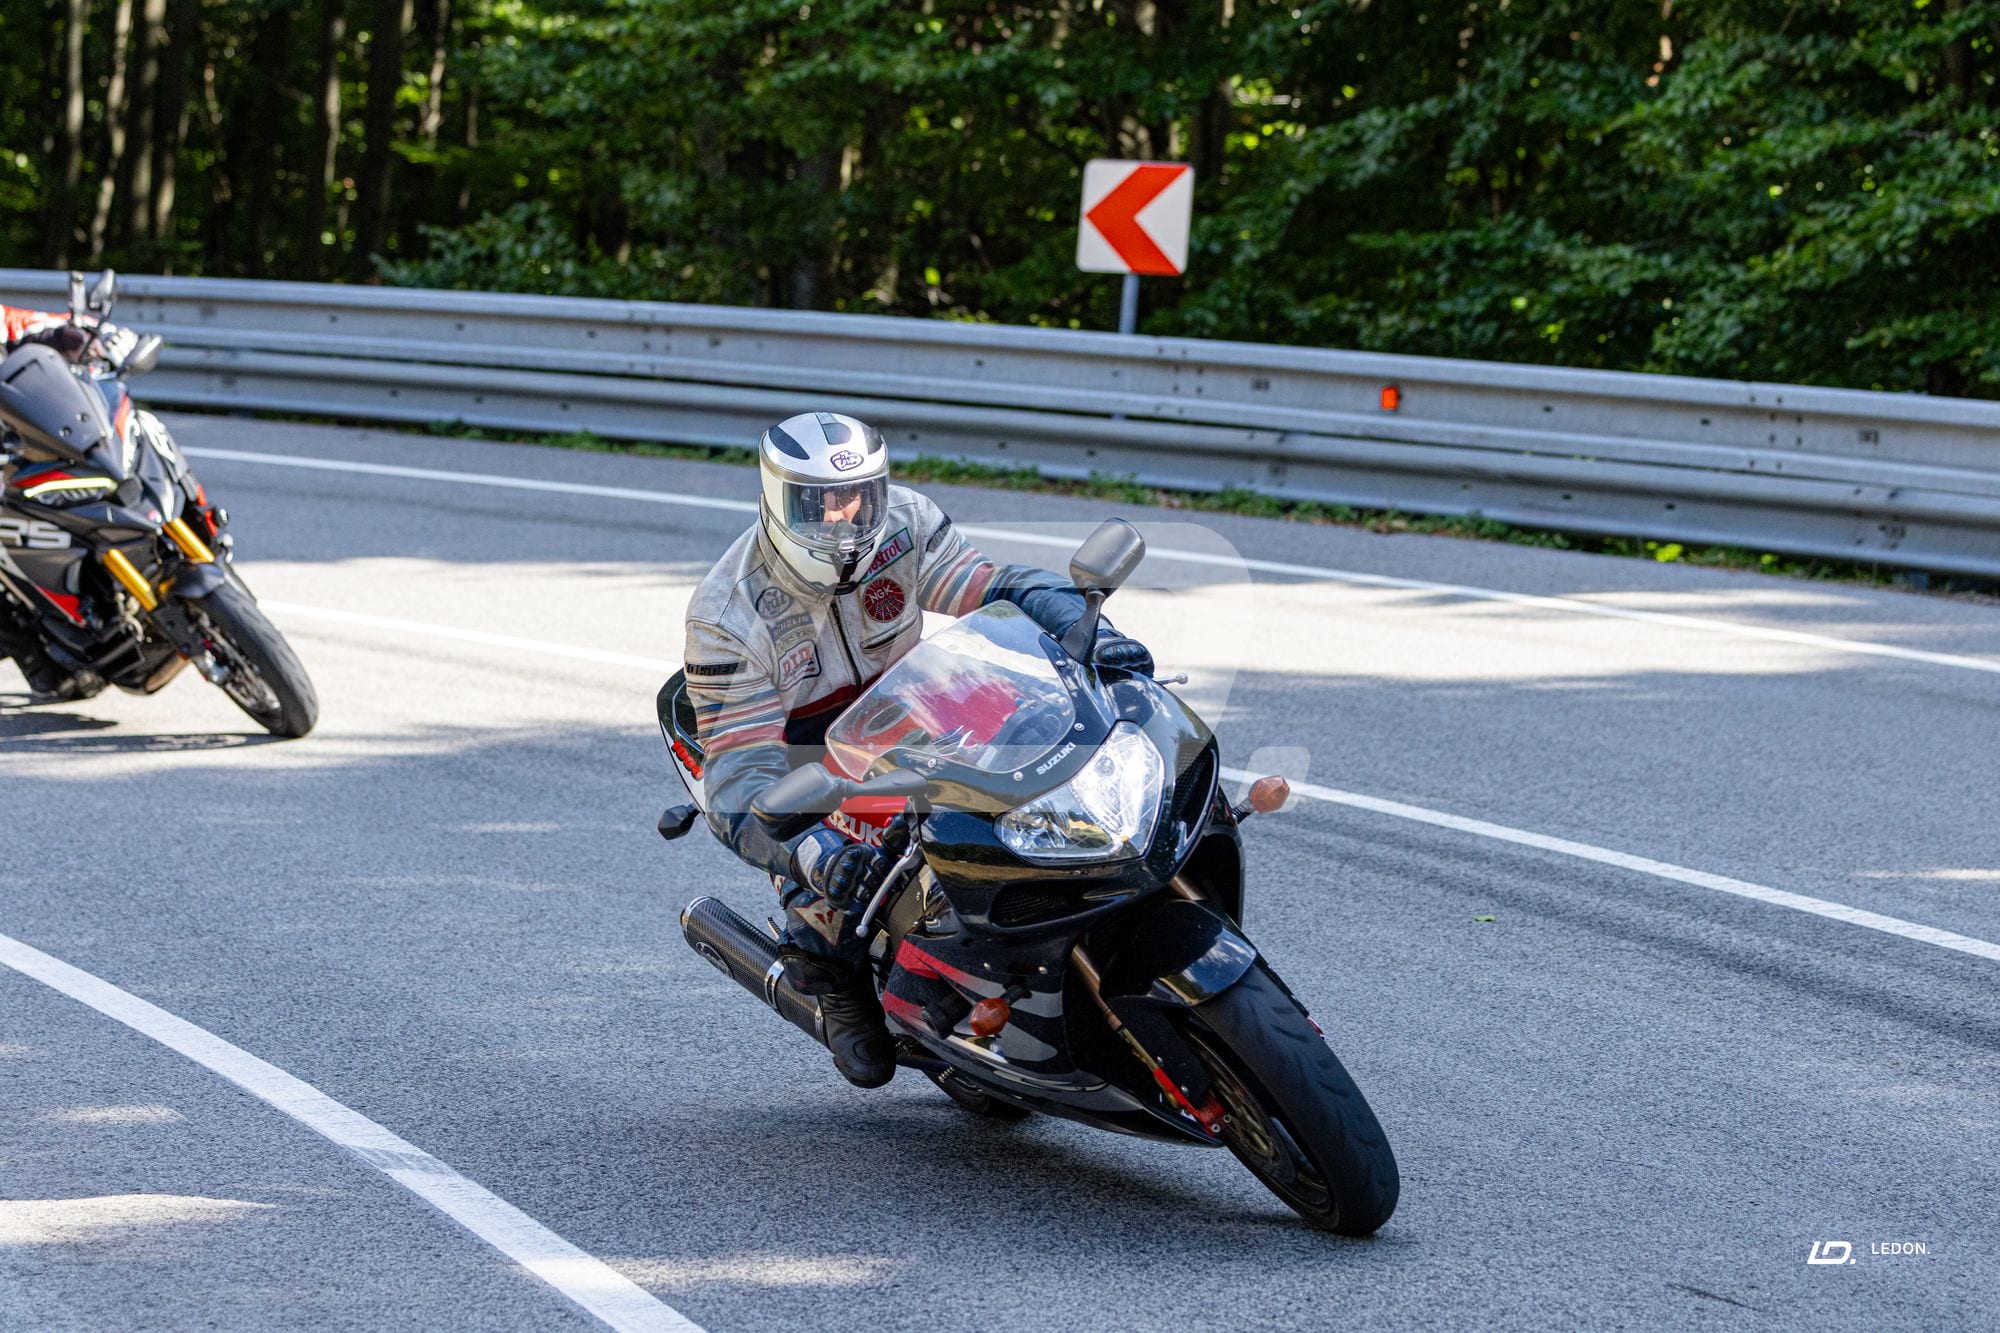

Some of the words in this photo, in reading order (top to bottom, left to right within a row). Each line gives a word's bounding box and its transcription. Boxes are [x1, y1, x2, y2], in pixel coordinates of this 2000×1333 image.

[868, 539, 902, 574] astrol
[869, 585, 894, 604] NGK
[1036, 741, 1076, 775] SUZUKI
